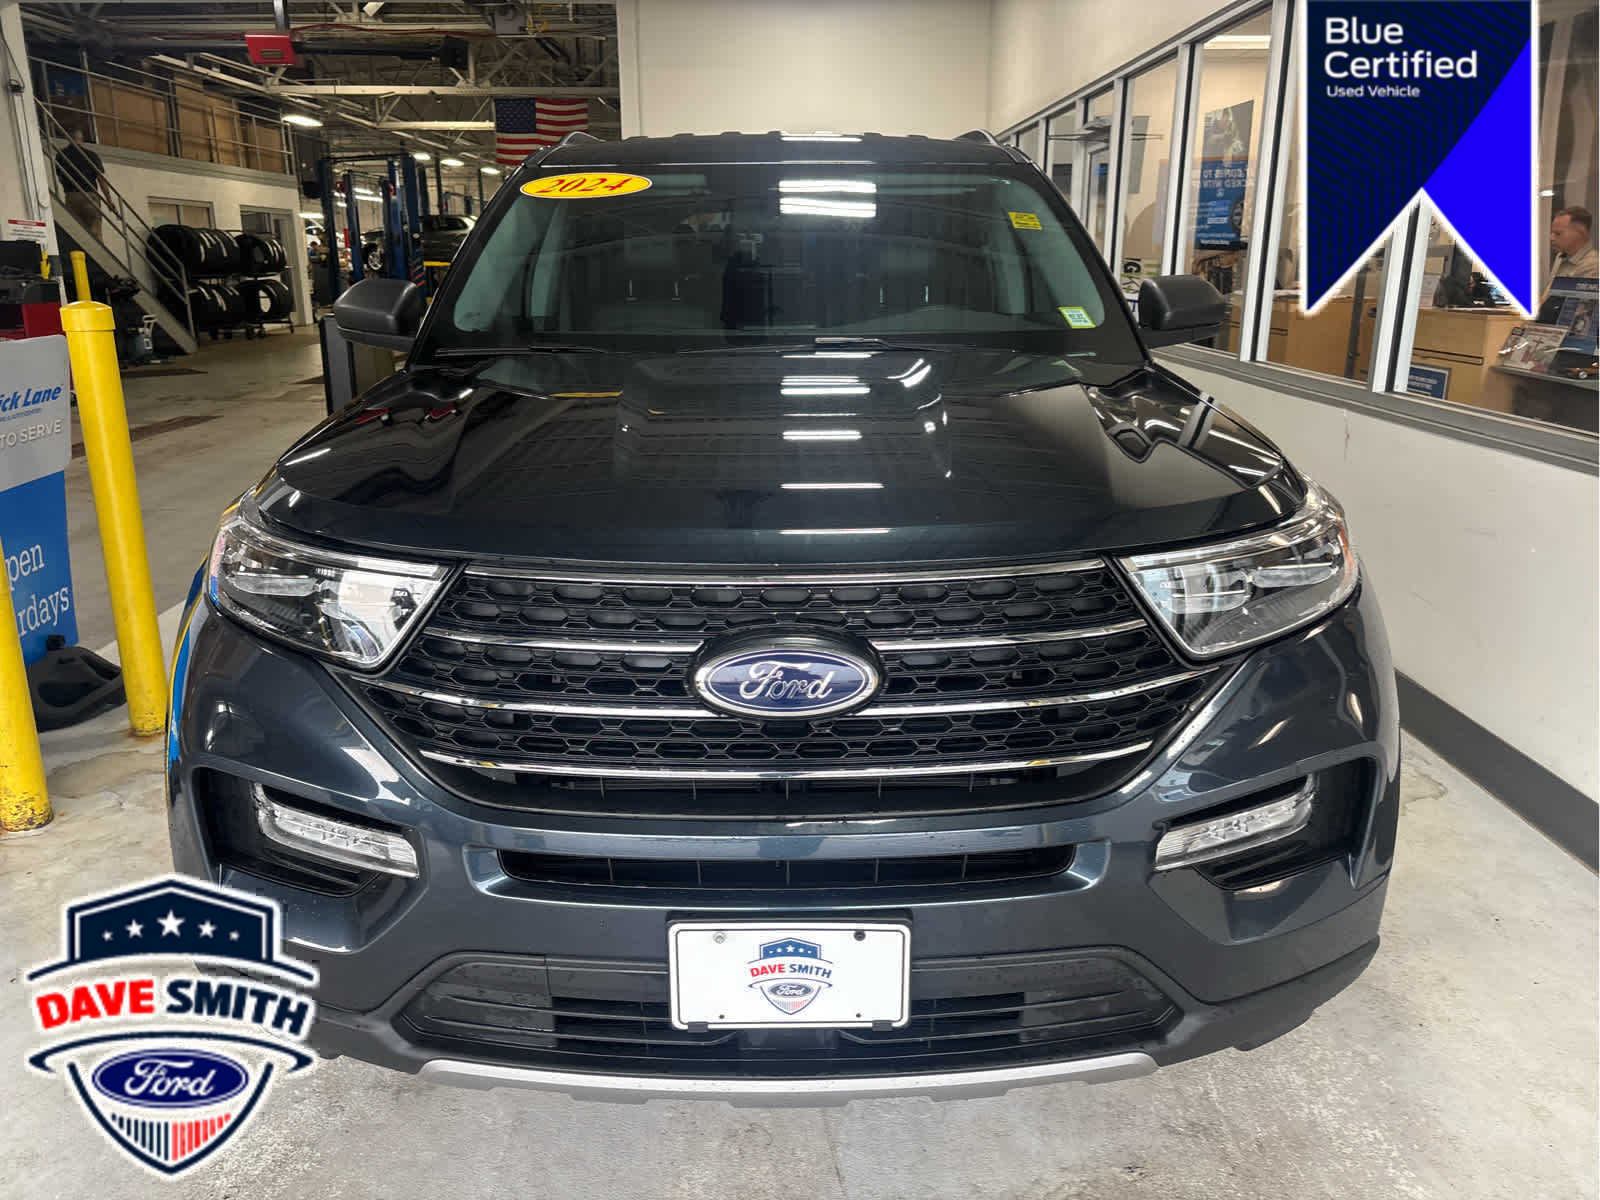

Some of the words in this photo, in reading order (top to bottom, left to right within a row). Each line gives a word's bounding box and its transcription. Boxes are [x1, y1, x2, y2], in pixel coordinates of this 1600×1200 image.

[534, 177, 633, 194] 2024
[22, 386, 63, 408] Lane
[0, 431, 17, 449] TO
[19, 419, 62, 443] SERVE
[739, 660, 836, 700] Ford
[749, 963, 786, 978] DAVE
[788, 963, 833, 979] SMITH
